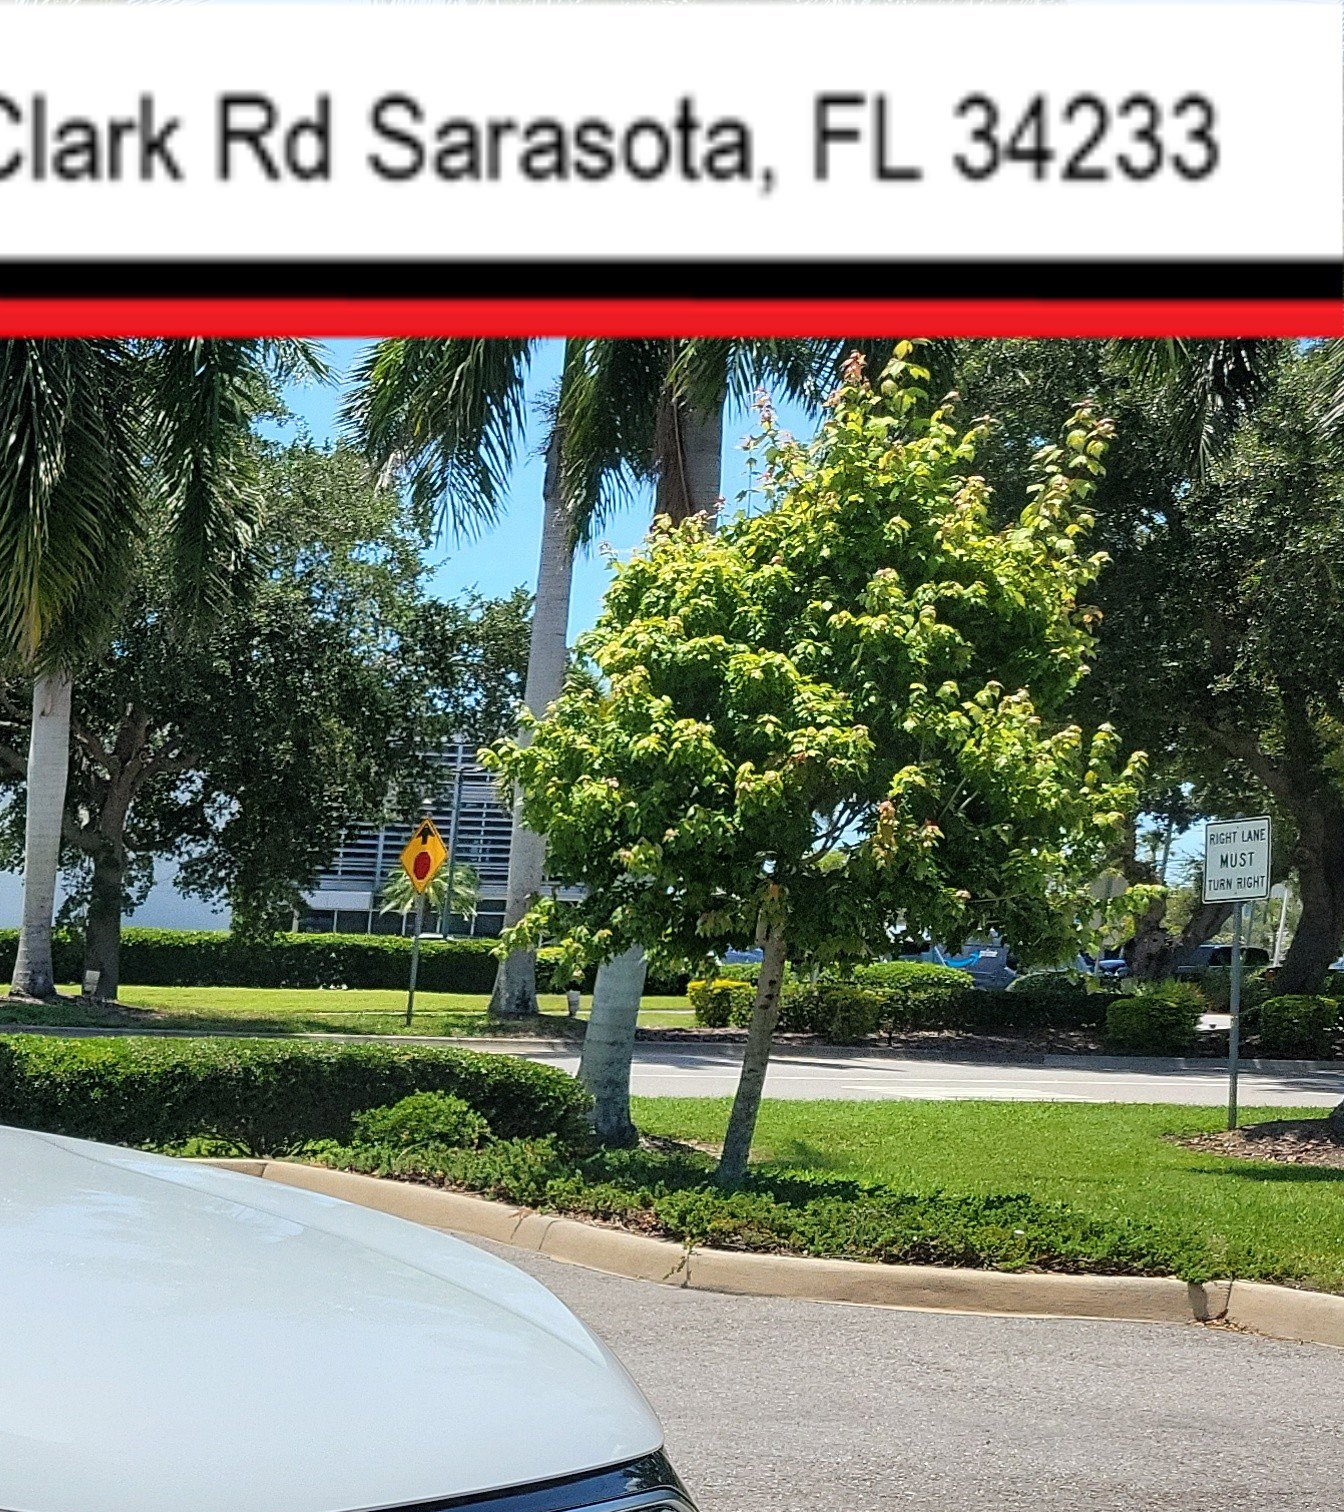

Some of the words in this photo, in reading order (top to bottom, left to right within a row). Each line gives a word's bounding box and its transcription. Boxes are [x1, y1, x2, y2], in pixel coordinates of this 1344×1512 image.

[1209, 831, 1237, 845] RIGHT
[1241, 828, 1266, 842] LANE
[1220, 852, 1255, 868] MUST
[1208, 878, 1232, 891] TURN
[1236, 875, 1266, 889] RIGHT
